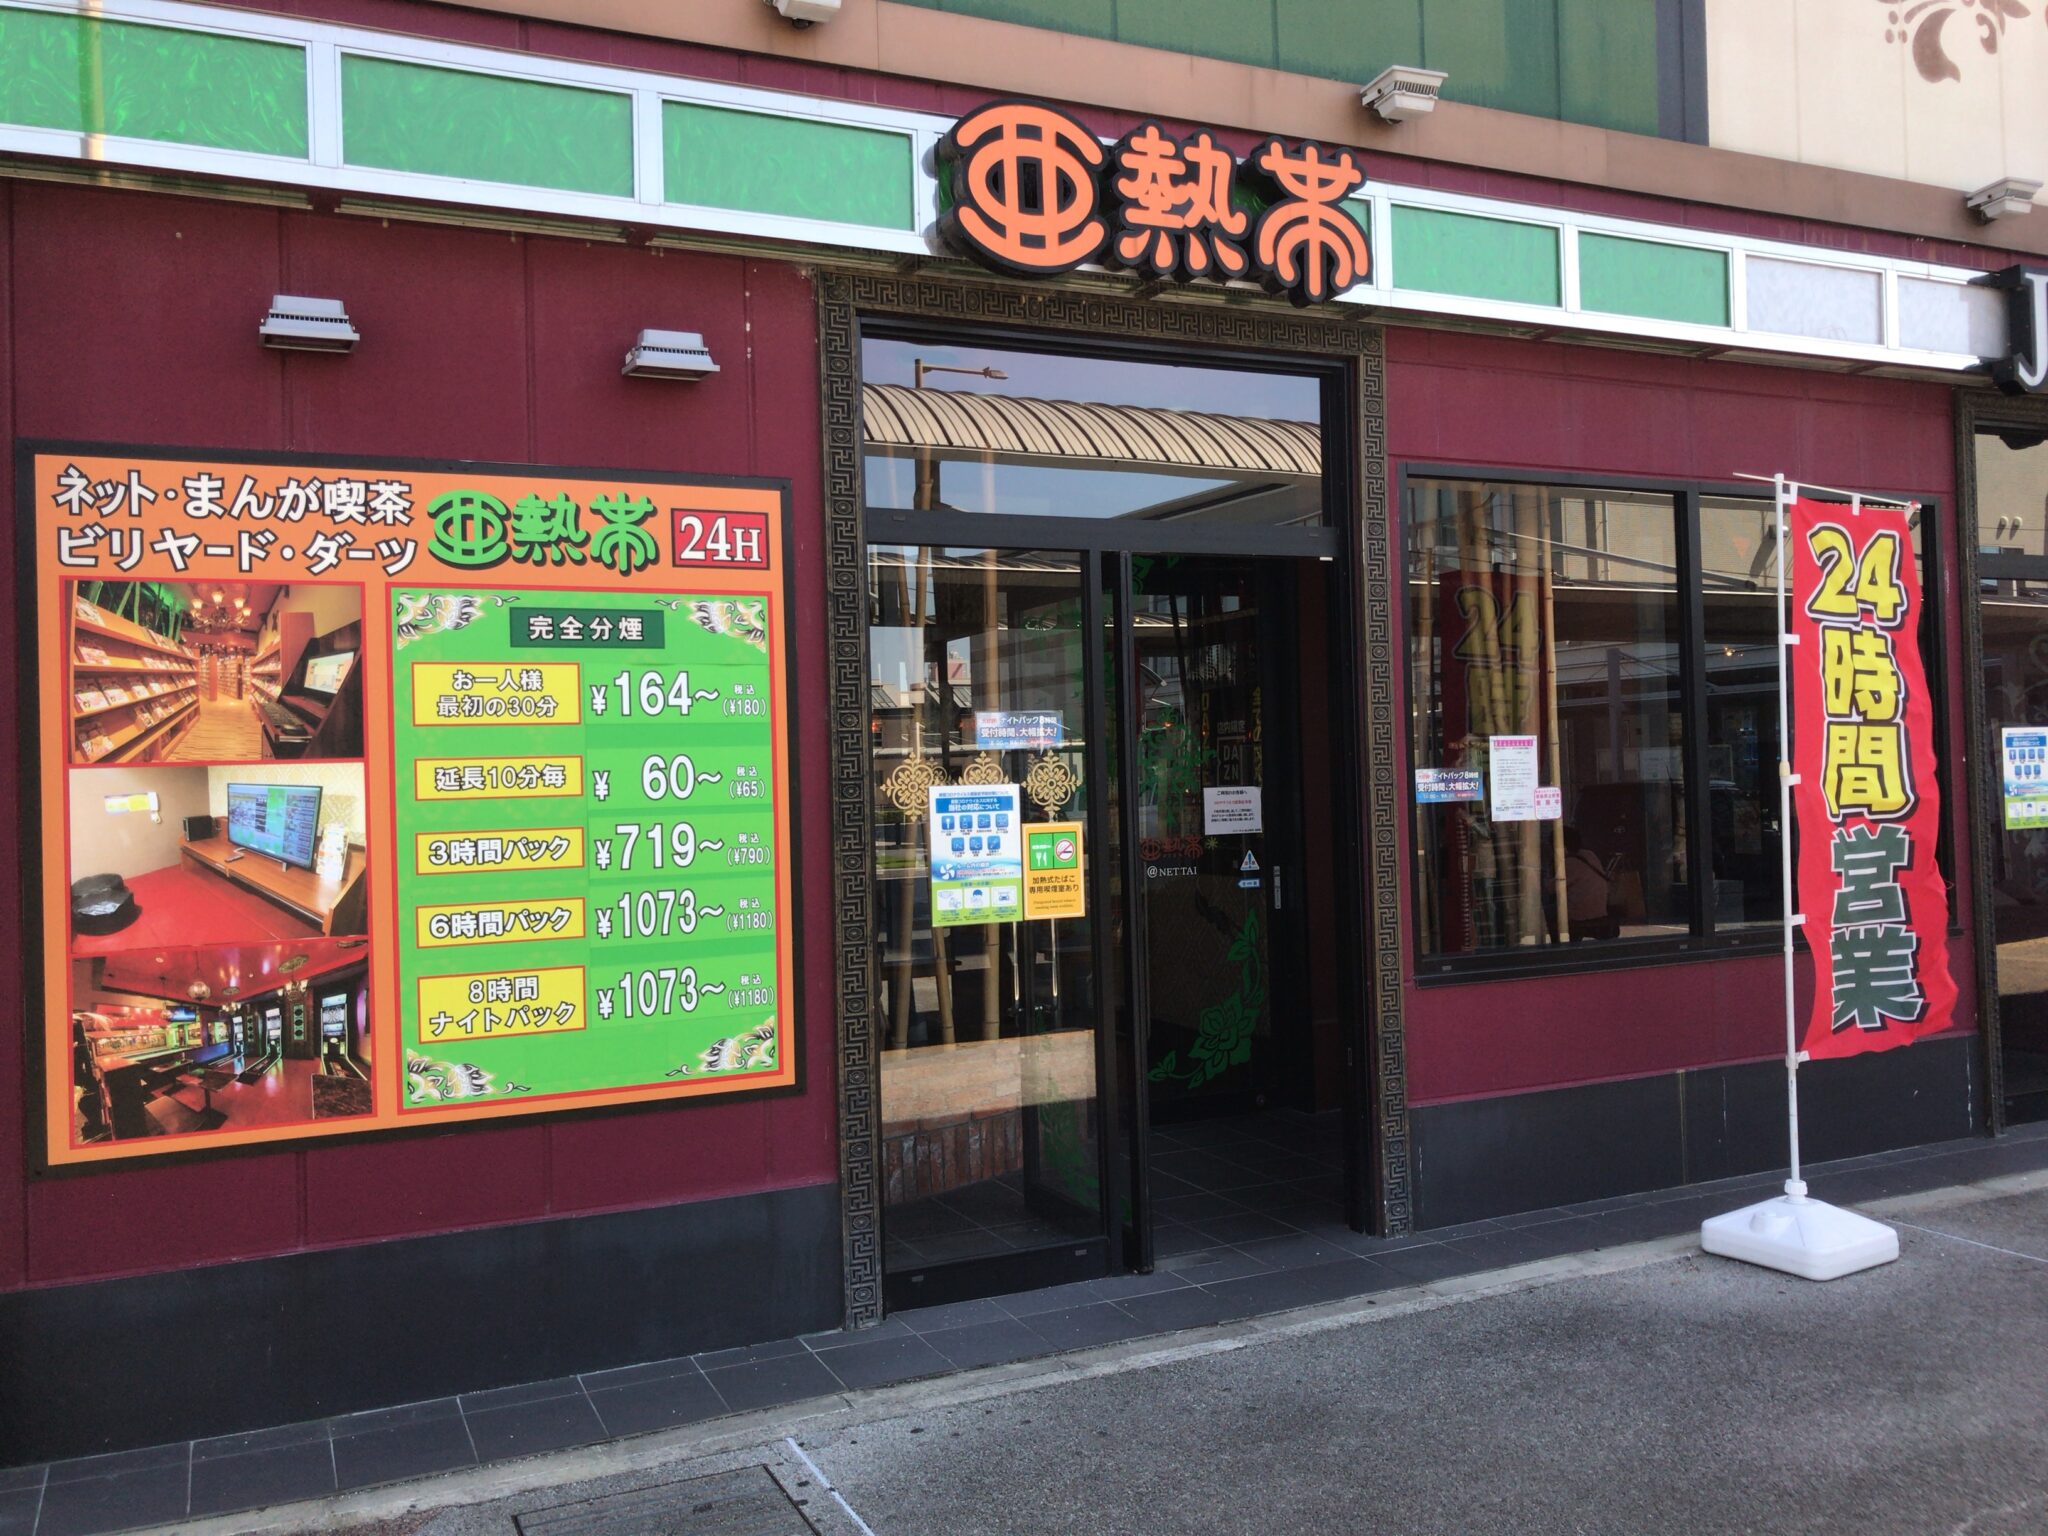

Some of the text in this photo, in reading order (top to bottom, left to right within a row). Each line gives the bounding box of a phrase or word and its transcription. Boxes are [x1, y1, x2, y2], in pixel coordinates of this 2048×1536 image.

[52, 464, 416, 527] ネット・まんが喫茶
[56, 522, 418, 576] ビリヤード・ダーツ
[679, 515, 763, 563] 24H
[529, 615, 644, 642] 完全分煙
[452, 669, 544, 692] お一人様
[437, 695, 558, 718] 最初の30分
[434, 764, 566, 792] 延長10分毎
[429, 836, 570, 866] 3時間パック
[429, 907, 573, 939] 6時間パック
[468, 976, 540, 1003] 8時間
[429, 1002, 577, 1037] ナイトパック
